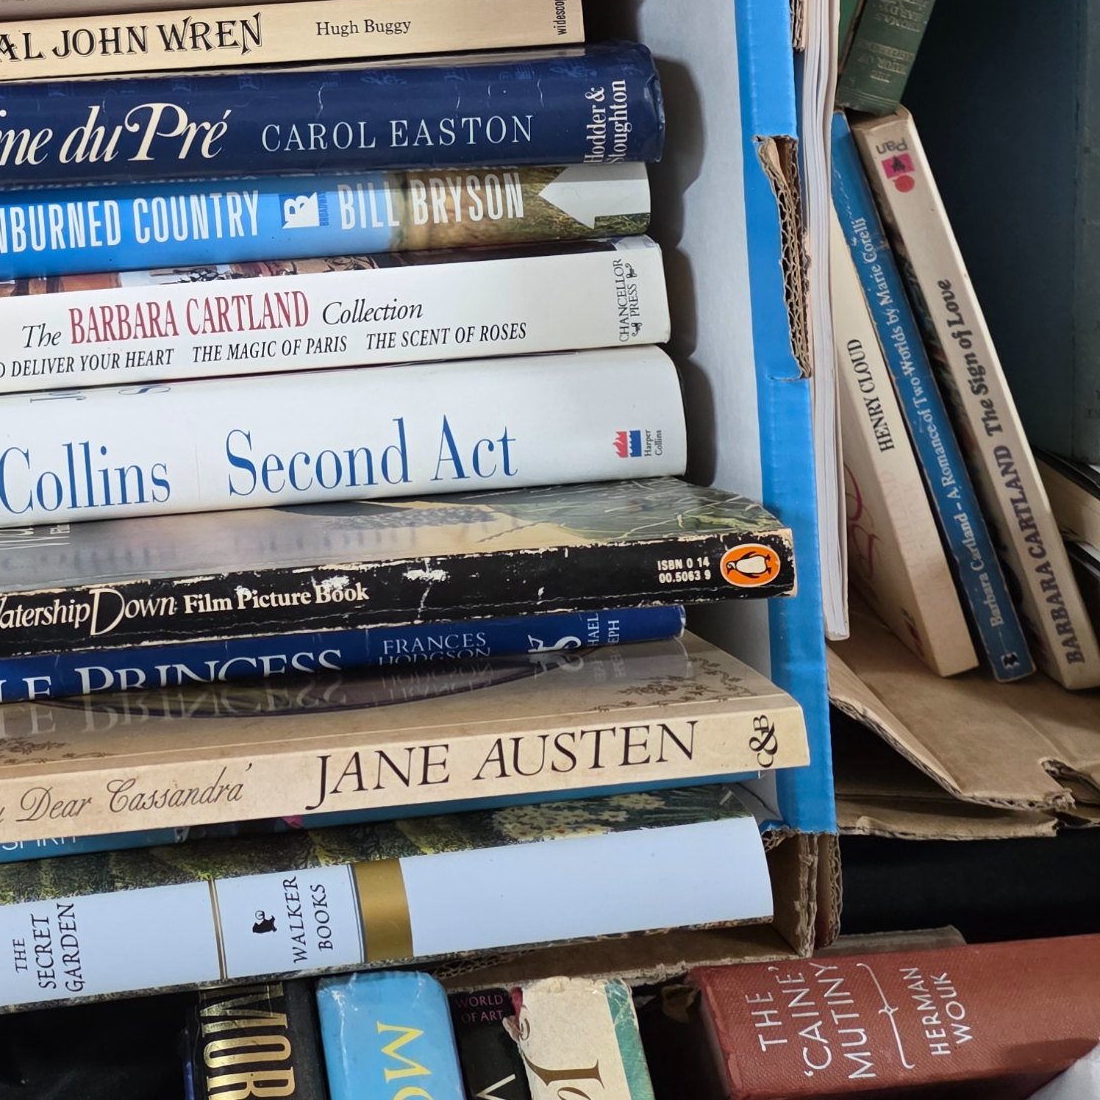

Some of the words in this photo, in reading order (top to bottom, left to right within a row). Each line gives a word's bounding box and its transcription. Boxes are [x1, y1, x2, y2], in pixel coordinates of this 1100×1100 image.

[51, 25, 150, 60] JOHN
[156, 11, 264, 56] WREN
[316, 21, 359, 38] Hugh
[364, 18, 412, 36] Buggy
[59, 105, 124, 162] du
[124, 102, 232, 163] Pré
[261, 120, 377, 153] CAROL
[389, 114, 534, 147] EASTON
[876, 137, 908, 155] Pan
[133, 190, 260, 244] COUNTRY
[337, 180, 400, 231] BILL
[412, 171, 524, 226] BRYSON
[21, 323, 62, 348] The
[68, 300, 180, 345] BARBARA
[185, 289, 309, 336] CARTLAND
[321, 298, 424, 326] Collection
[618, 258, 631, 342] CHANCELLOR
[629, 284, 641, 318] PRESS
[938, 279, 964, 327] Love
[10, 357, 75, 377] DELIVER
[80, 352, 121, 372] YOUR
[124, 348, 175, 368] HEART
[192, 344, 222, 363] THE
[226, 341, 277, 360] MAGIC
[281, 339, 302, 356] OF
[305, 335, 348, 355] PARIS
[366, 332, 396, 350] THE
[400, 327, 451, 348] SCENT
[454, 325, 477, 343] OF
[479, 322, 527, 342] ROSES
[846, 338, 876, 392] CLOUD
[951, 329, 972, 350] of
[964, 352, 989, 396] Sign
[644, 429, 653, 457] Harper
[654, 429, 663, 456] Collins
[863, 393, 895, 453] HENRY
[981, 398, 1003, 437] The
[225, 417, 412, 497] Second
[430, 413, 519, 481] Act
[994, 445, 1046, 560] CARTLAND
[1036, 561, 1084, 664] BARBARA
[383, 632, 486, 654] FRANCES
[306, 743, 450, 811] JANE
[473, 720, 699, 781] AUSTEN
[283, 876, 309, 963] WALKER
[312, 884, 334, 950] BOOKS
[13, 937, 28, 973] THE
[30, 914, 57, 990] SECRET
[56, 903, 85, 993] GARDEN
[746, 992, 787, 1051] THE
[810, 962, 877, 1079] MUTINY
[900, 968, 950, 1055] HERMAN
[930, 972, 972, 1044] WOUK
